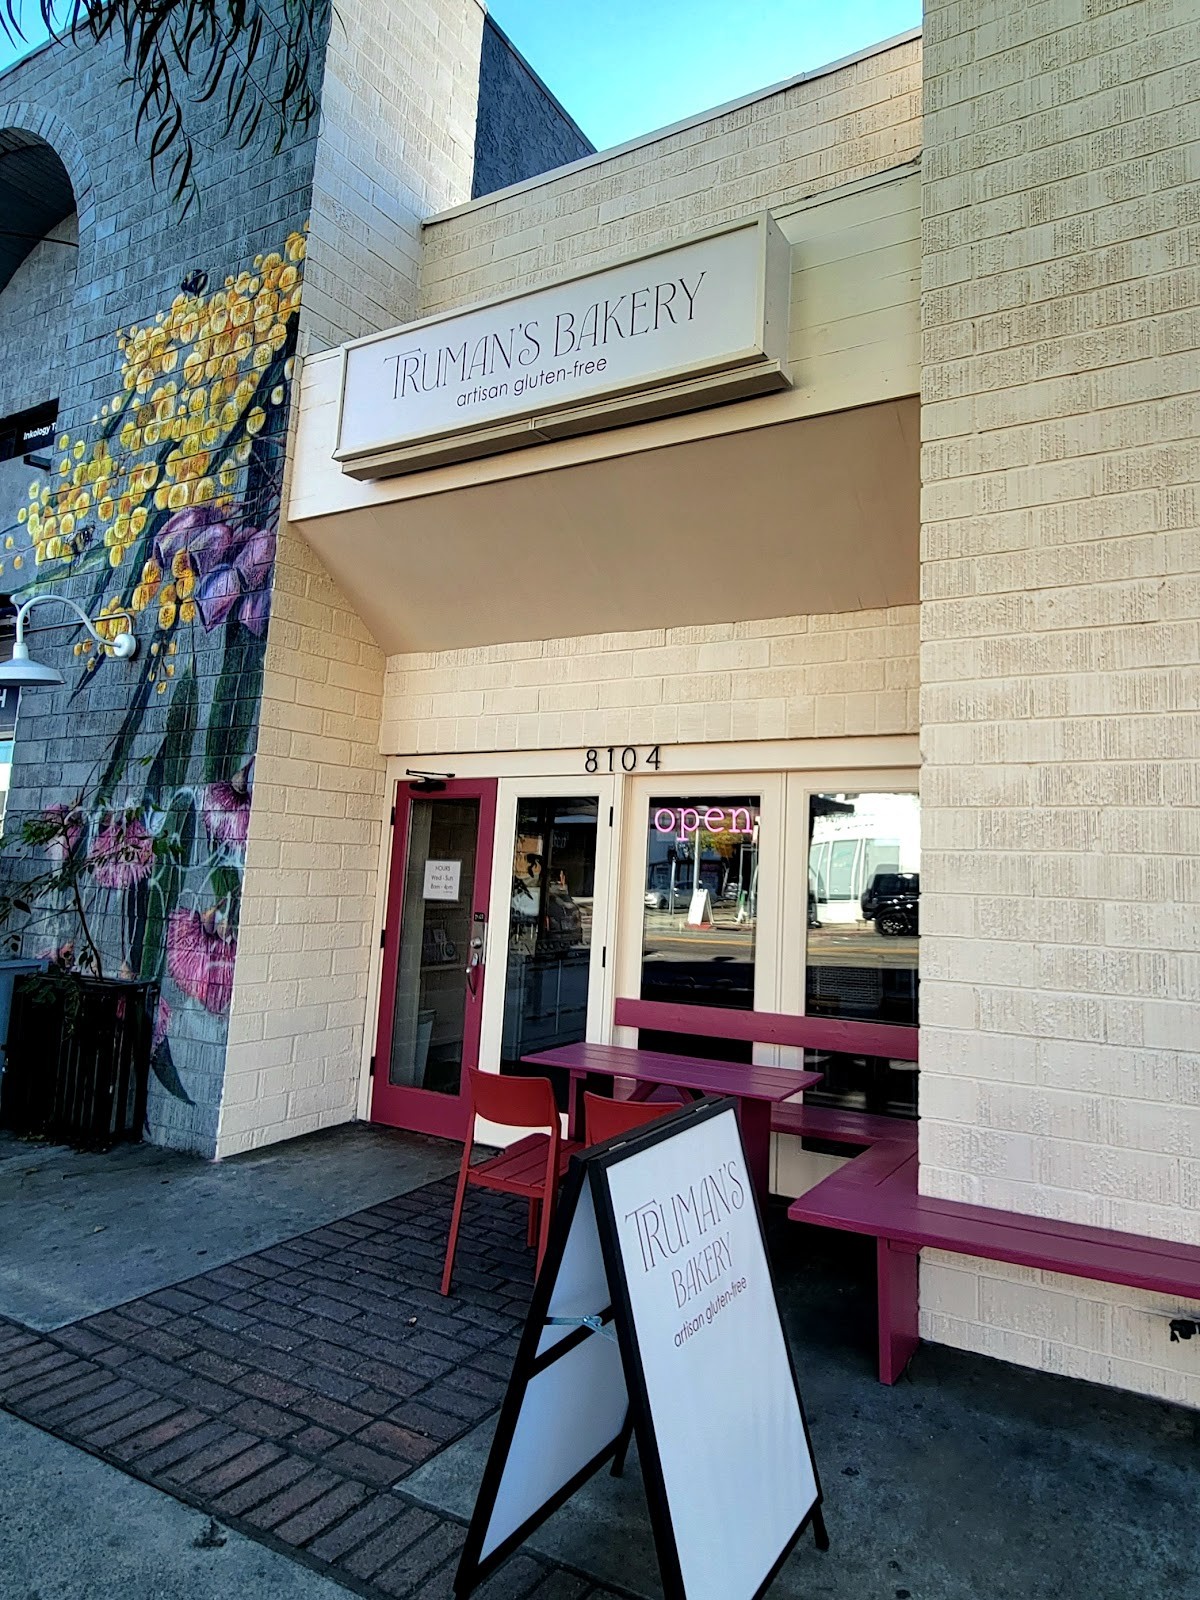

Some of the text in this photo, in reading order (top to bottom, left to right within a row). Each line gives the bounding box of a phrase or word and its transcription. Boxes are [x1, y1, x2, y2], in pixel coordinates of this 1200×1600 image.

[383, 270, 707, 401] TRUMAN'S BAKERY
[456, 354, 608, 408] artisan gluten-free
[23, 425, 51, 440] Inkology
[584, 745, 662, 773] 8104
[654, 806, 753, 841] open
[624, 1160, 745, 1273] TRUMAN'S
[671, 1231, 734, 1309] BAKERY
[674, 1276, 748, 1348] artisan gluten-free
